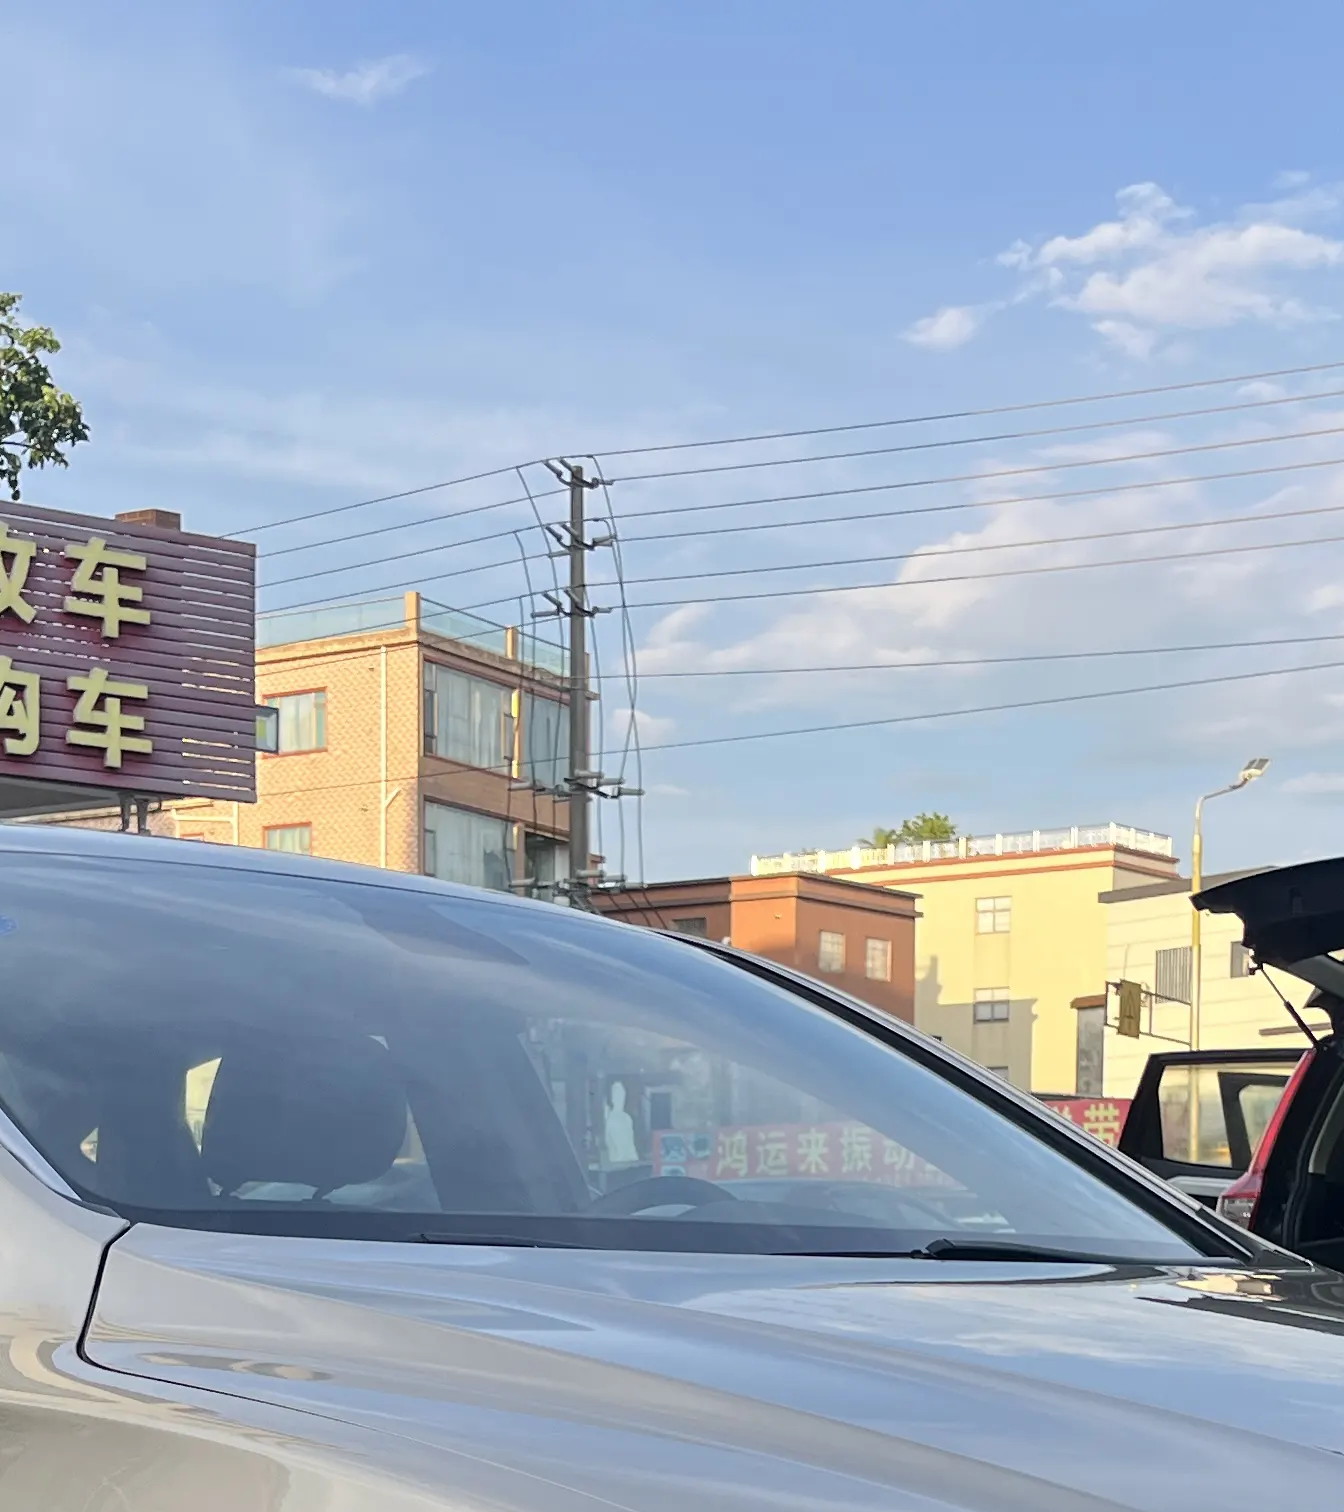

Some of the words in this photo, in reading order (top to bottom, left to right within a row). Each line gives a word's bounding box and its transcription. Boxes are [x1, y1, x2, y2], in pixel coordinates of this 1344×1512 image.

[714, 1126, 944, 1179] 鸿运来振动
